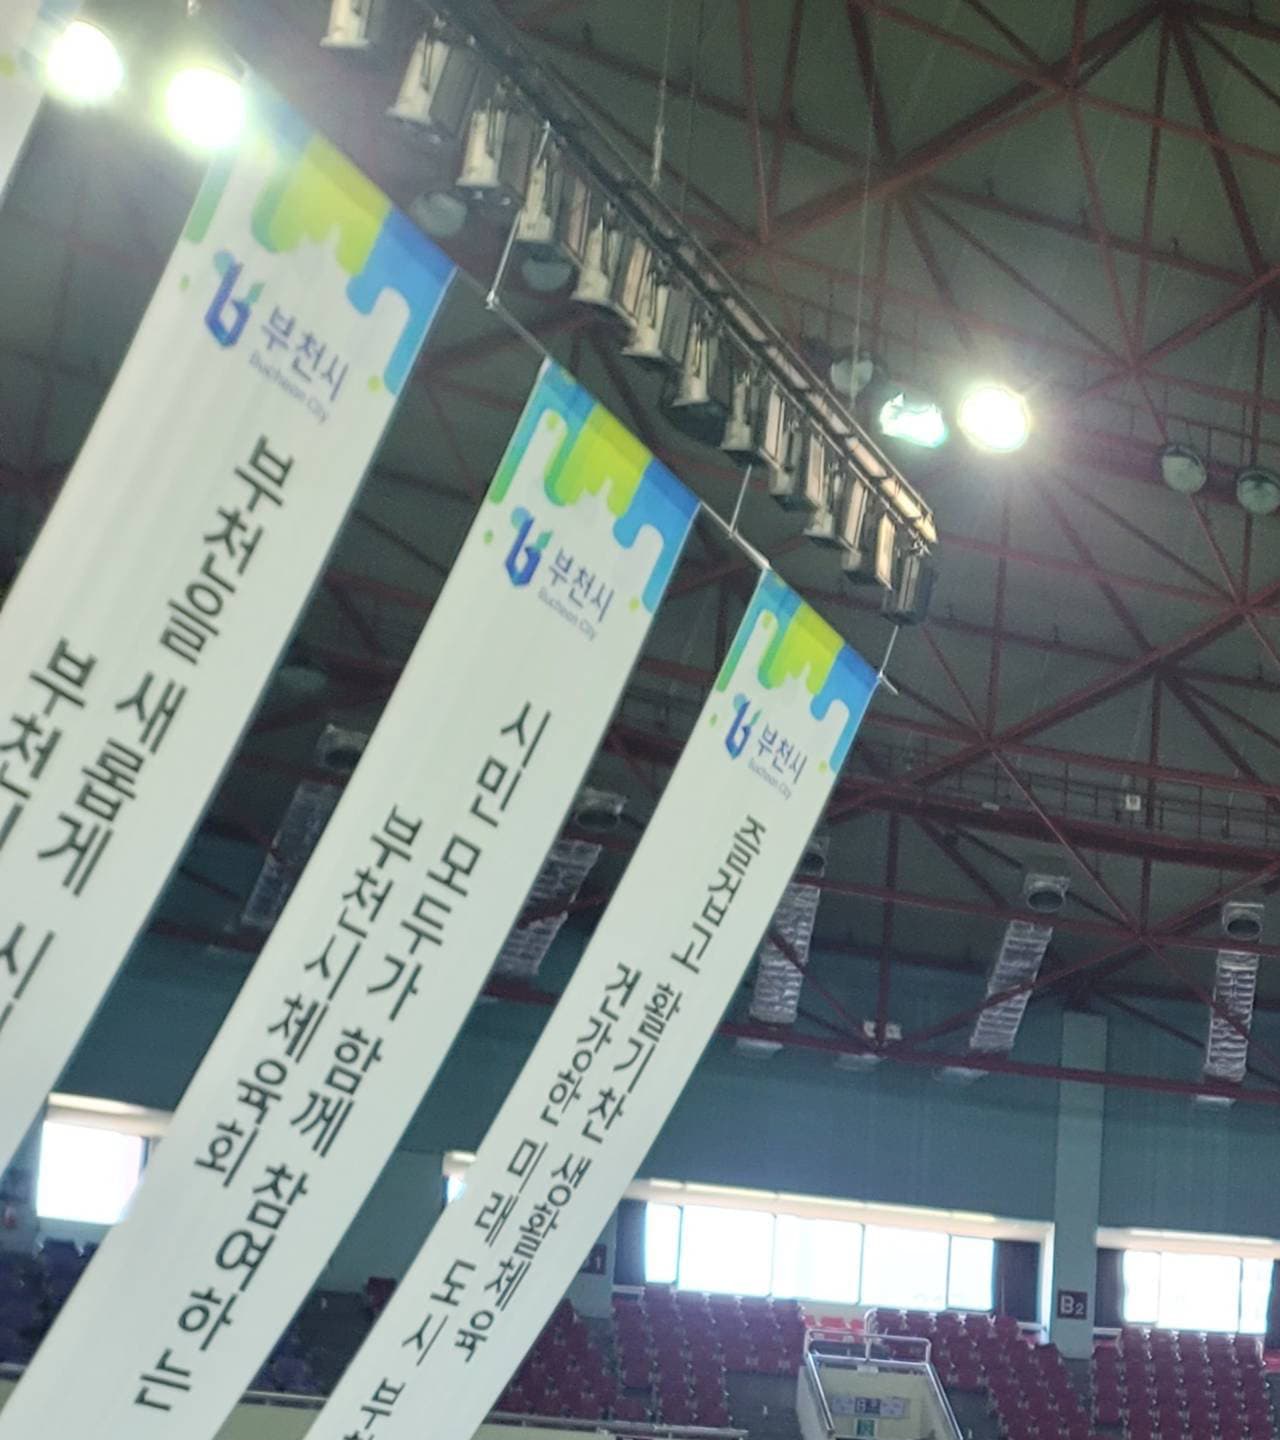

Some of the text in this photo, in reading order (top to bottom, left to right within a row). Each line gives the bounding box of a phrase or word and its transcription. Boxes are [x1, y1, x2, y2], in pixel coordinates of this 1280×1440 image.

[262, 305, 349, 402] 부천시
[548, 547, 615, 624] 부천시
[37, 434, 294, 898] 부천을 새롭게
[0, 637, 98, 852] 부천
[470, 701, 551, 829] 시민
[756, 722, 808, 785] 부천시
[367, 833, 483, 1022] 모두가
[194, 804, 424, 1189] 부천시체육회
[540, 963, 641, 1127] 건강한
[290, 1026, 385, 1158] 함께
[454, 815, 766, 1363] 즐겁고 활기찬 생활체육
[474, 1138, 549, 1247] 미래
[134, 1163, 309, 1412] 참여하는
[401, 1259, 477, 1367] 도시
[1059, 1294, 1085, 1316] B2
